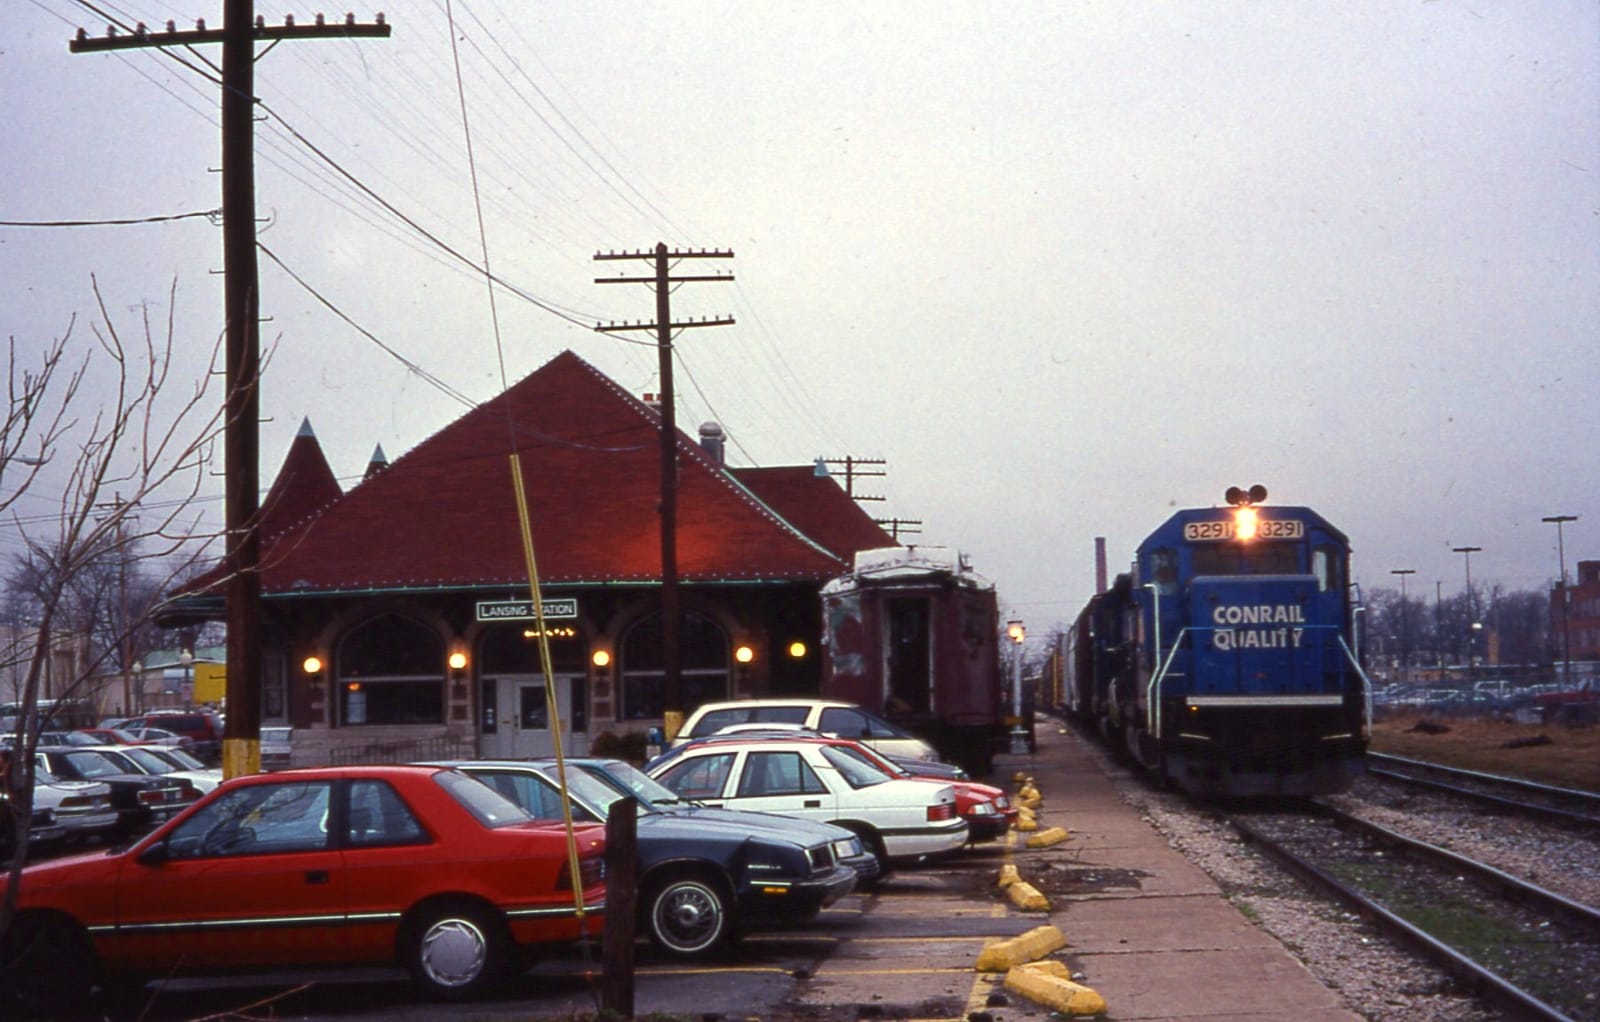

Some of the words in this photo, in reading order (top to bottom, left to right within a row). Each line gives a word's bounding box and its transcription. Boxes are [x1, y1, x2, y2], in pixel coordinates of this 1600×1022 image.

[1188, 523, 1230, 539] 3291
[1262, 521, 1301, 537] 3291
[481, 606, 527, 617] LANSING
[531, 604, 573, 615] SATION
[1213, 604, 1305, 624] CONRAIL
[1213, 629, 1304, 650] QUALITY
